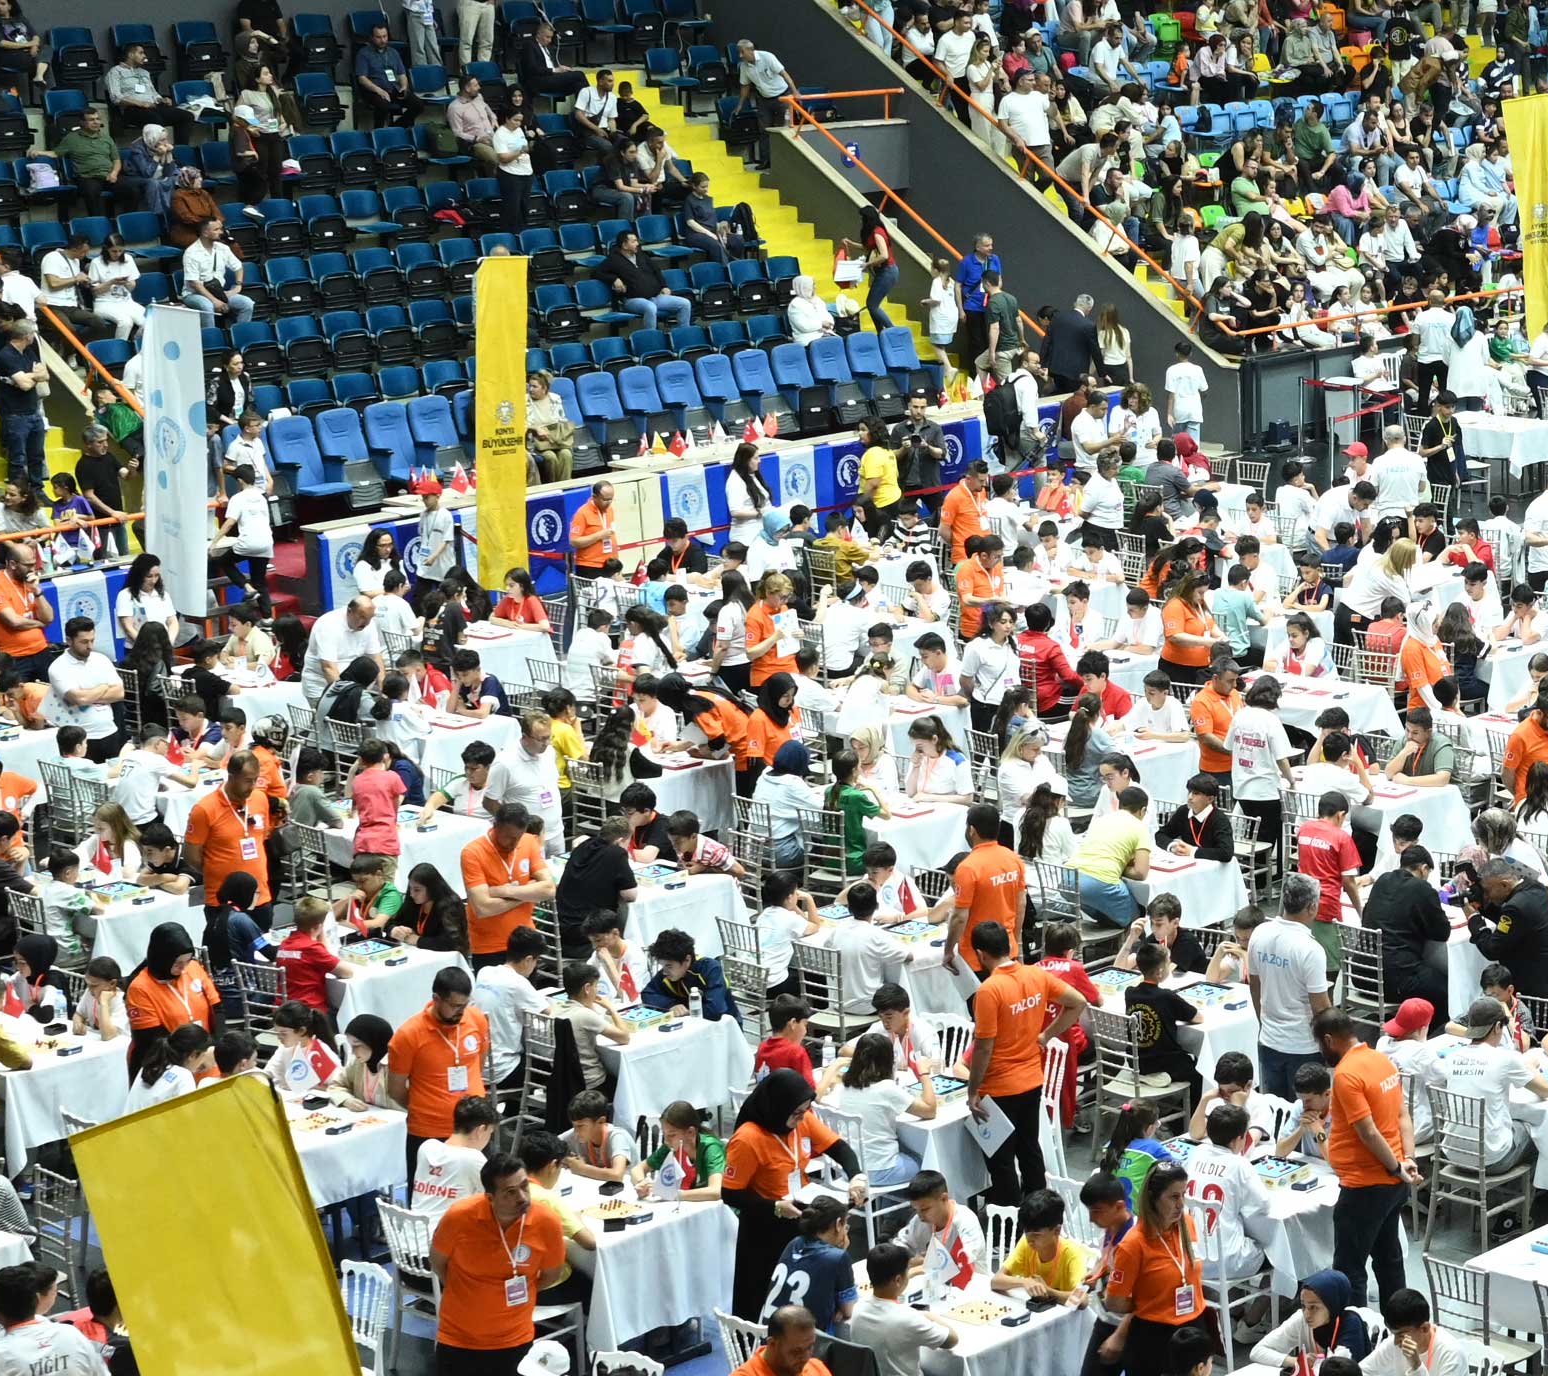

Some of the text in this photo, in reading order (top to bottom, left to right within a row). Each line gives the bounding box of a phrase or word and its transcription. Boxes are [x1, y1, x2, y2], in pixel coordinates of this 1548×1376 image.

[990, 870, 1019, 887] TAZOF
[1257, 951, 1290, 969] TAZOF
[1009, 992, 1042, 1016] TAZOF
[429, 1164, 443, 1177] 22
[1194, 1159, 1228, 1178] YILDIZ
